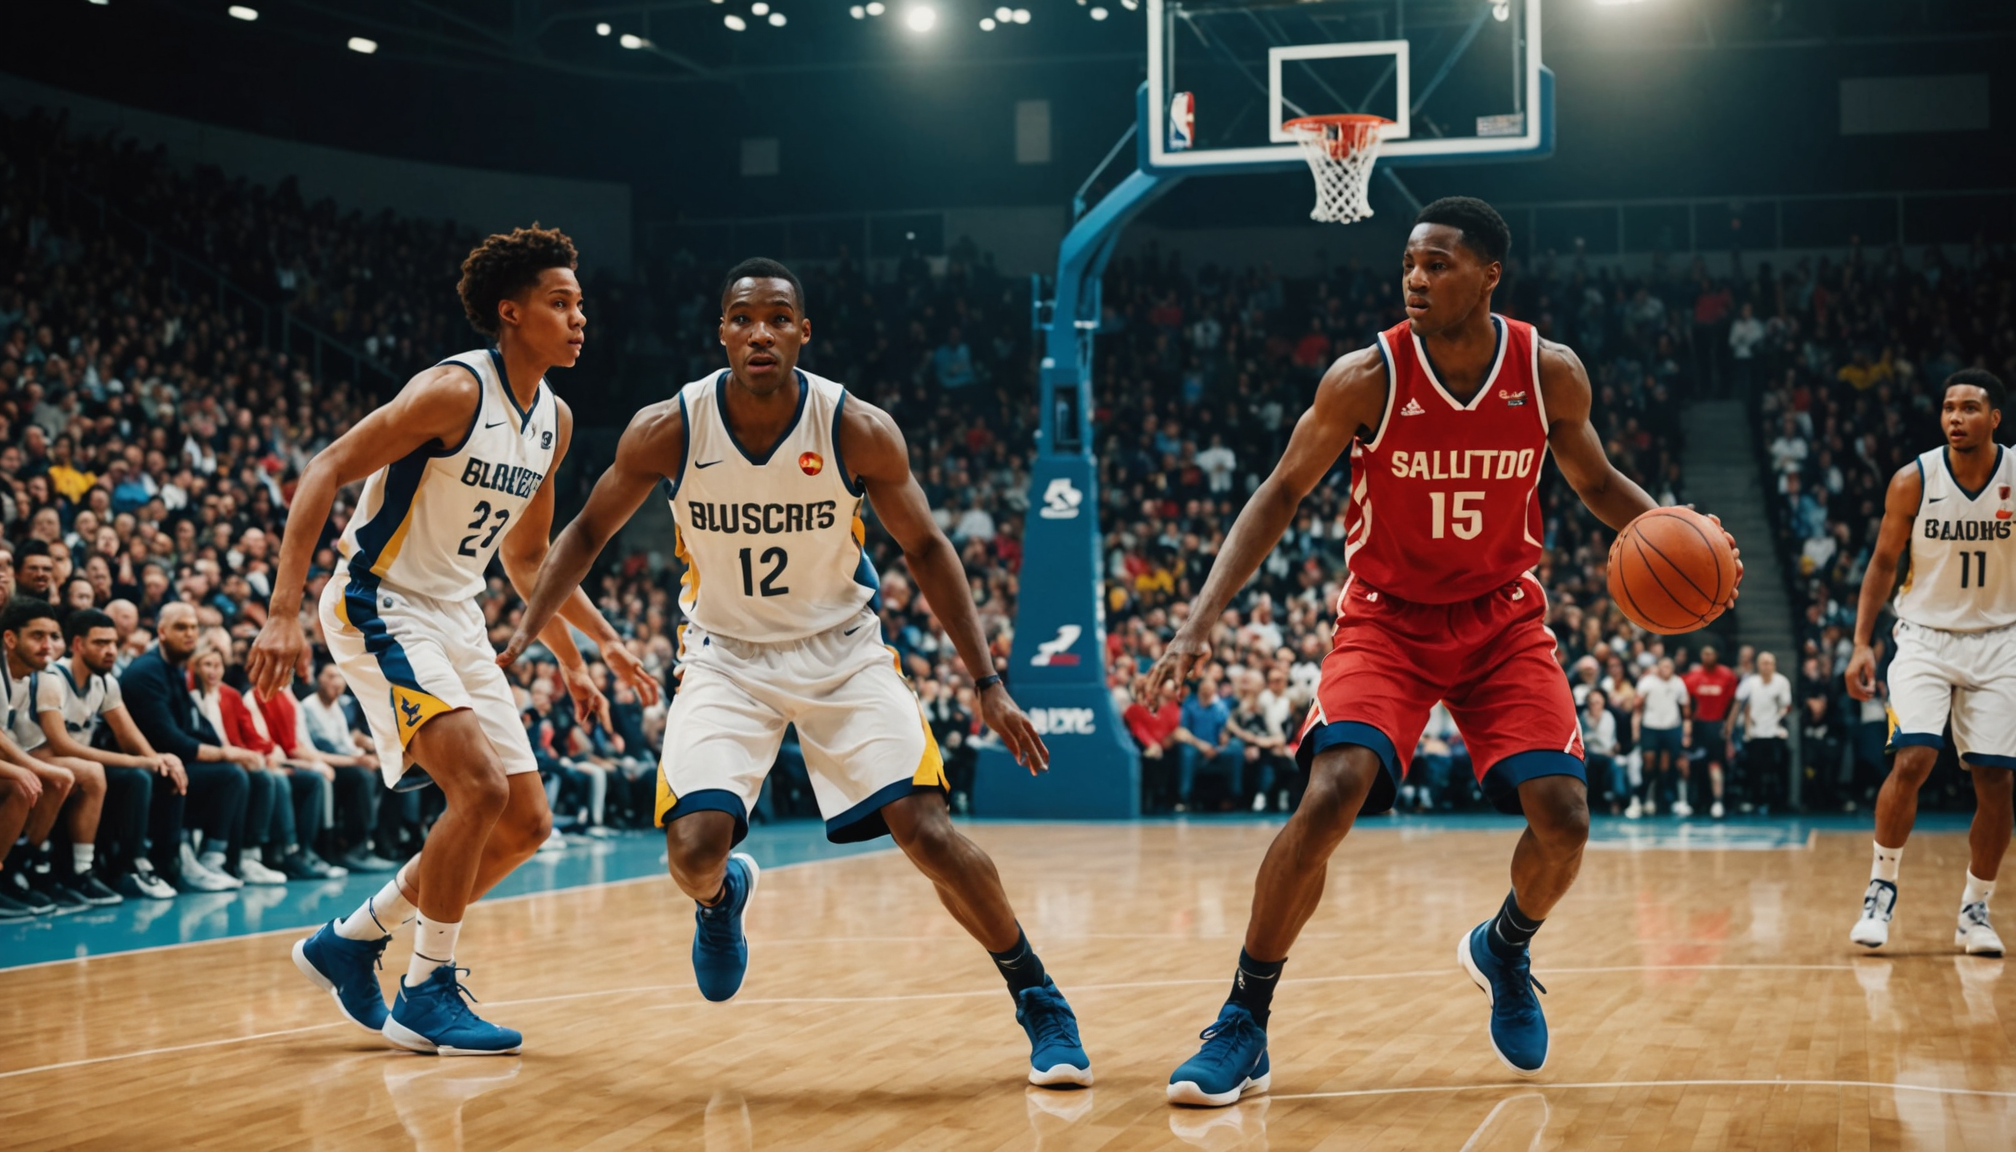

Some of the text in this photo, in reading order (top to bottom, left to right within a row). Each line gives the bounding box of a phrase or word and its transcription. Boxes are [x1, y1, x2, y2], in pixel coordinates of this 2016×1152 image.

[1391, 448, 1535, 480] SALUTDO
[1429, 491, 1486, 541] 15
[738, 546, 790, 597] 12
[1959, 551, 1987, 589] 11
